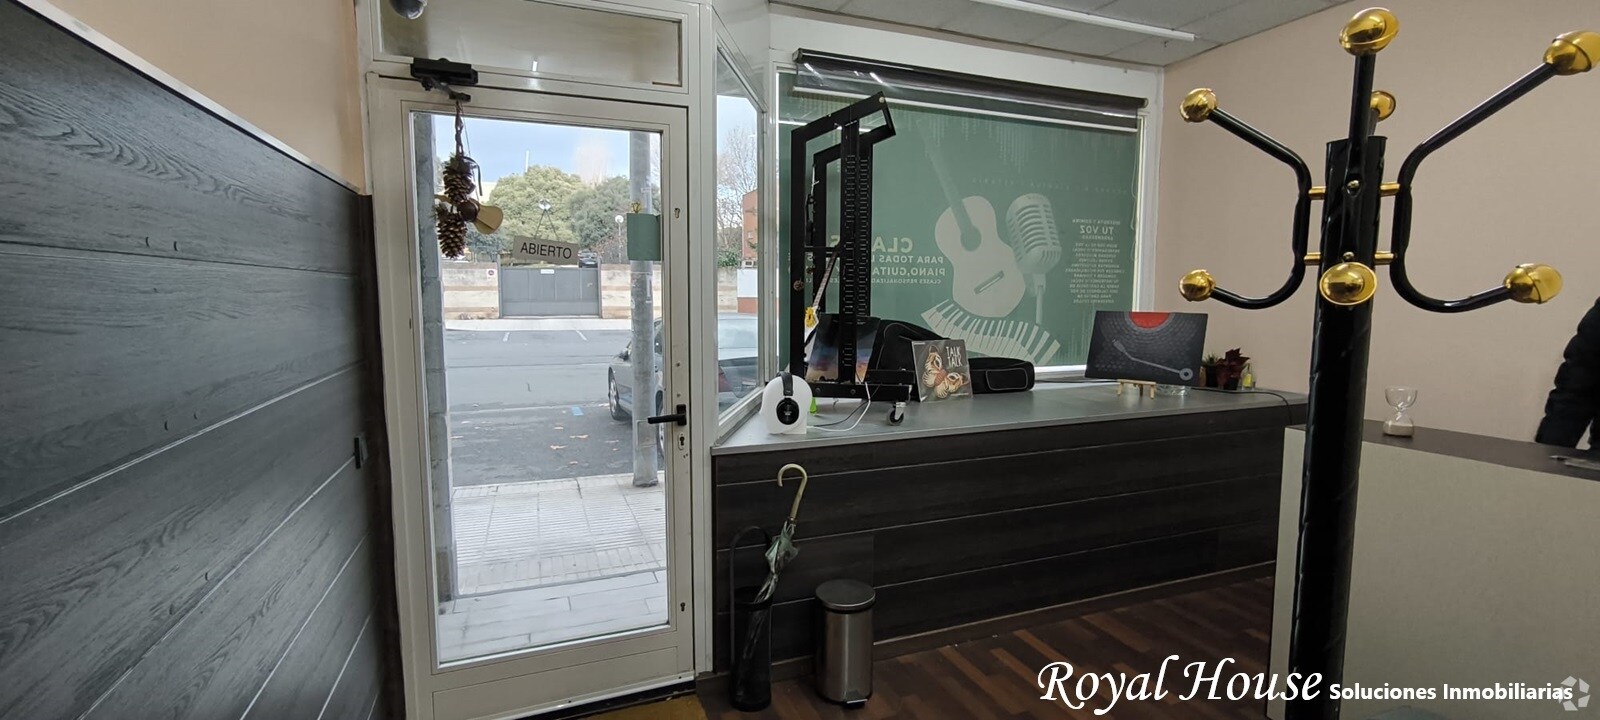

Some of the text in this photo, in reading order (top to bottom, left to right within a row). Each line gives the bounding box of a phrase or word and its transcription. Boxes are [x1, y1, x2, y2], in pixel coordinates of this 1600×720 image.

[520, 242, 572, 259] ABIERTO
[945, 346, 961, 357] TALK
[947, 356, 963, 368] TALK
